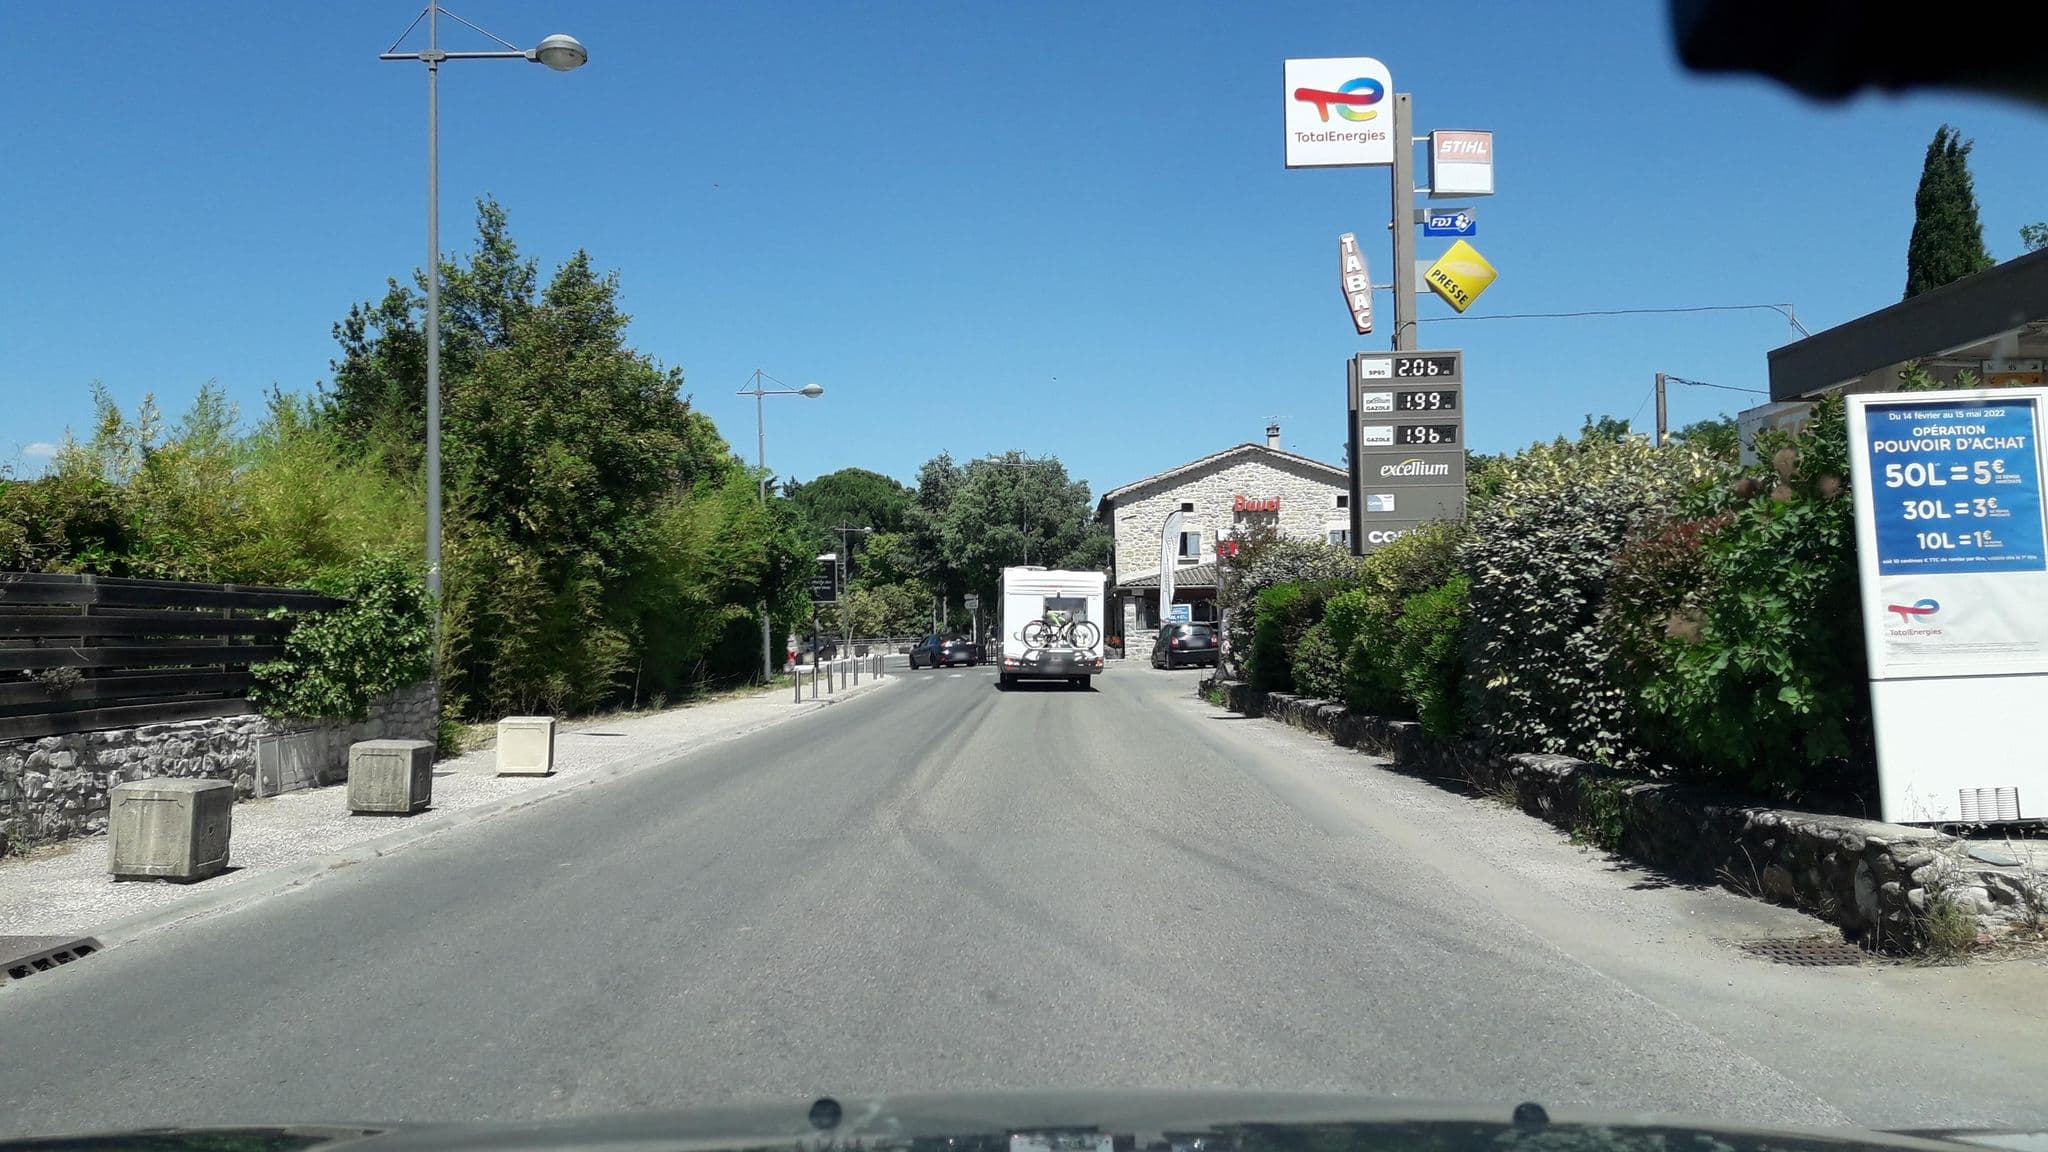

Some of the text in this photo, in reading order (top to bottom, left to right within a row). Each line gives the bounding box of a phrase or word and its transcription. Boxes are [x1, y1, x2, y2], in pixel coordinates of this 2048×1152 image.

[1294, 129, 1387, 144] TotalEnergies
[1440, 140, 1487, 153] STIHL
[1431, 217, 1452, 227] FDJ
[1341, 234, 1372, 329] TABAC
[1430, 268, 1469, 305] PRESSE
[1398, 359, 1438, 376] 2.06
[1407, 392, 1440, 410] 1.99
[1888, 409, 2006, 420] Du 14 février au 15 mai 2022
[1407, 426, 1440, 443] 1.96
[1912, 424, 1986, 437] OPÉRATION
[1874, 436, 2026, 453] POUVOIR D'ACHAT
[1380, 460, 1449, 477] excellium
[1885, 462, 1947, 488] 50L
[1902, 500, 1952, 520] 30L
[1916, 532, 1956, 550] 10L
